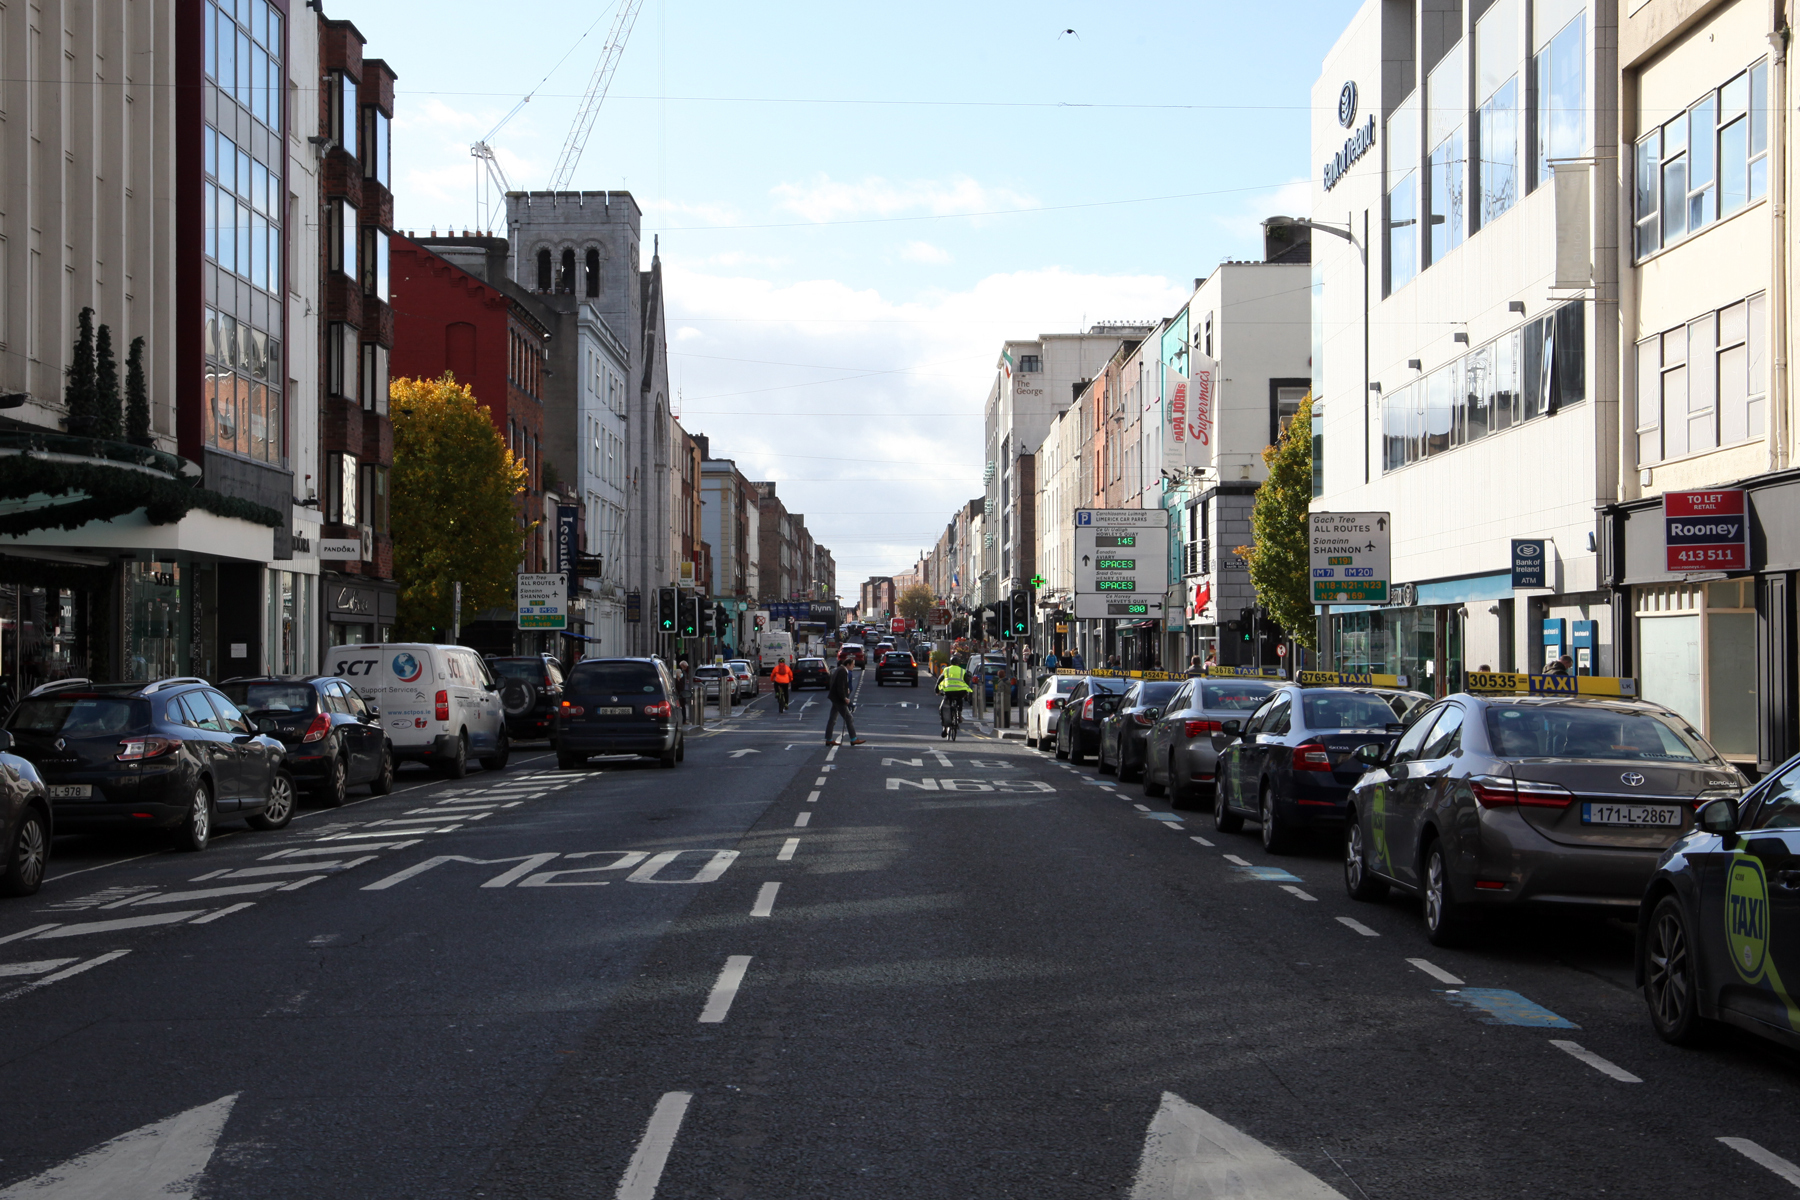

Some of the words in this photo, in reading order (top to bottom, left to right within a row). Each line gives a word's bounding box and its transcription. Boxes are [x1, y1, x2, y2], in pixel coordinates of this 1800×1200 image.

[1016, 387, 1043, 396] George
[1173, 383, 1187, 415] JOHNS
[1173, 417, 1185, 442] PAPA
[1687, 495, 1702, 504] TO
[1704, 494, 1723, 503] LET
[1671, 523, 1738, 538] Rooney
[1678, 550, 1704, 561] 413
[1707, 549, 1733, 560] 511
[1100, 560, 1134, 568] SPACES
[1100, 582, 1134, 590] SPACES
[333, 660, 378, 676] SCT
[1214, 666, 1236, 674] 36783
[1236, 667, 1260, 676] TAXI
[1302, 672, 1334, 683] 37654
[1340, 674, 1372, 685] TAXI
[1470, 674, 1516, 688] 30535
[1531, 676, 1576, 691] TAXI
[885, 778, 1057, 793] N69
[1597, 806, 1675, 824] 171-L-2867
[359, 848, 741, 891] M20
[1731, 894, 1764, 940] TAXI
